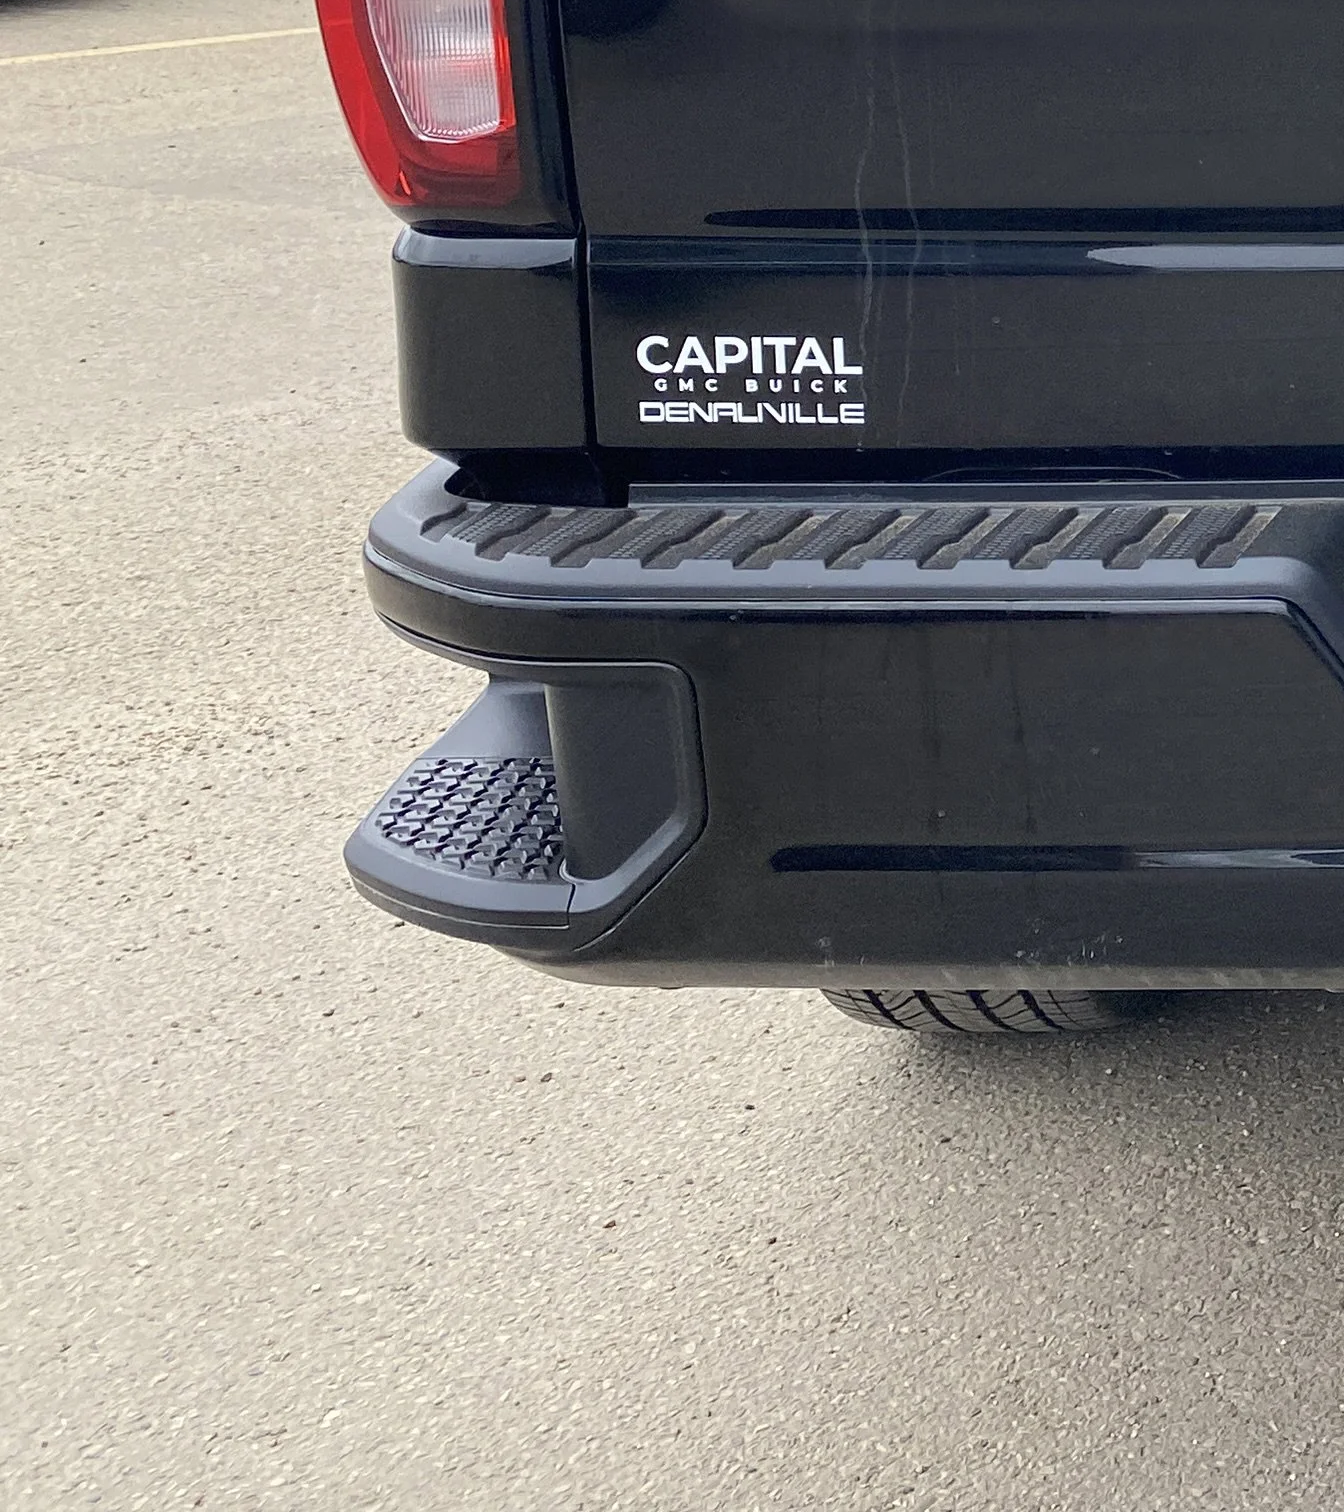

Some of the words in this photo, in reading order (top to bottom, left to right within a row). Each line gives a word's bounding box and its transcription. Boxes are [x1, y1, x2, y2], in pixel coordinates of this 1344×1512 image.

[636, 335, 863, 375] CAPITAL
[654, 378, 718, 392] GMC
[745, 379, 848, 394] BUICK
